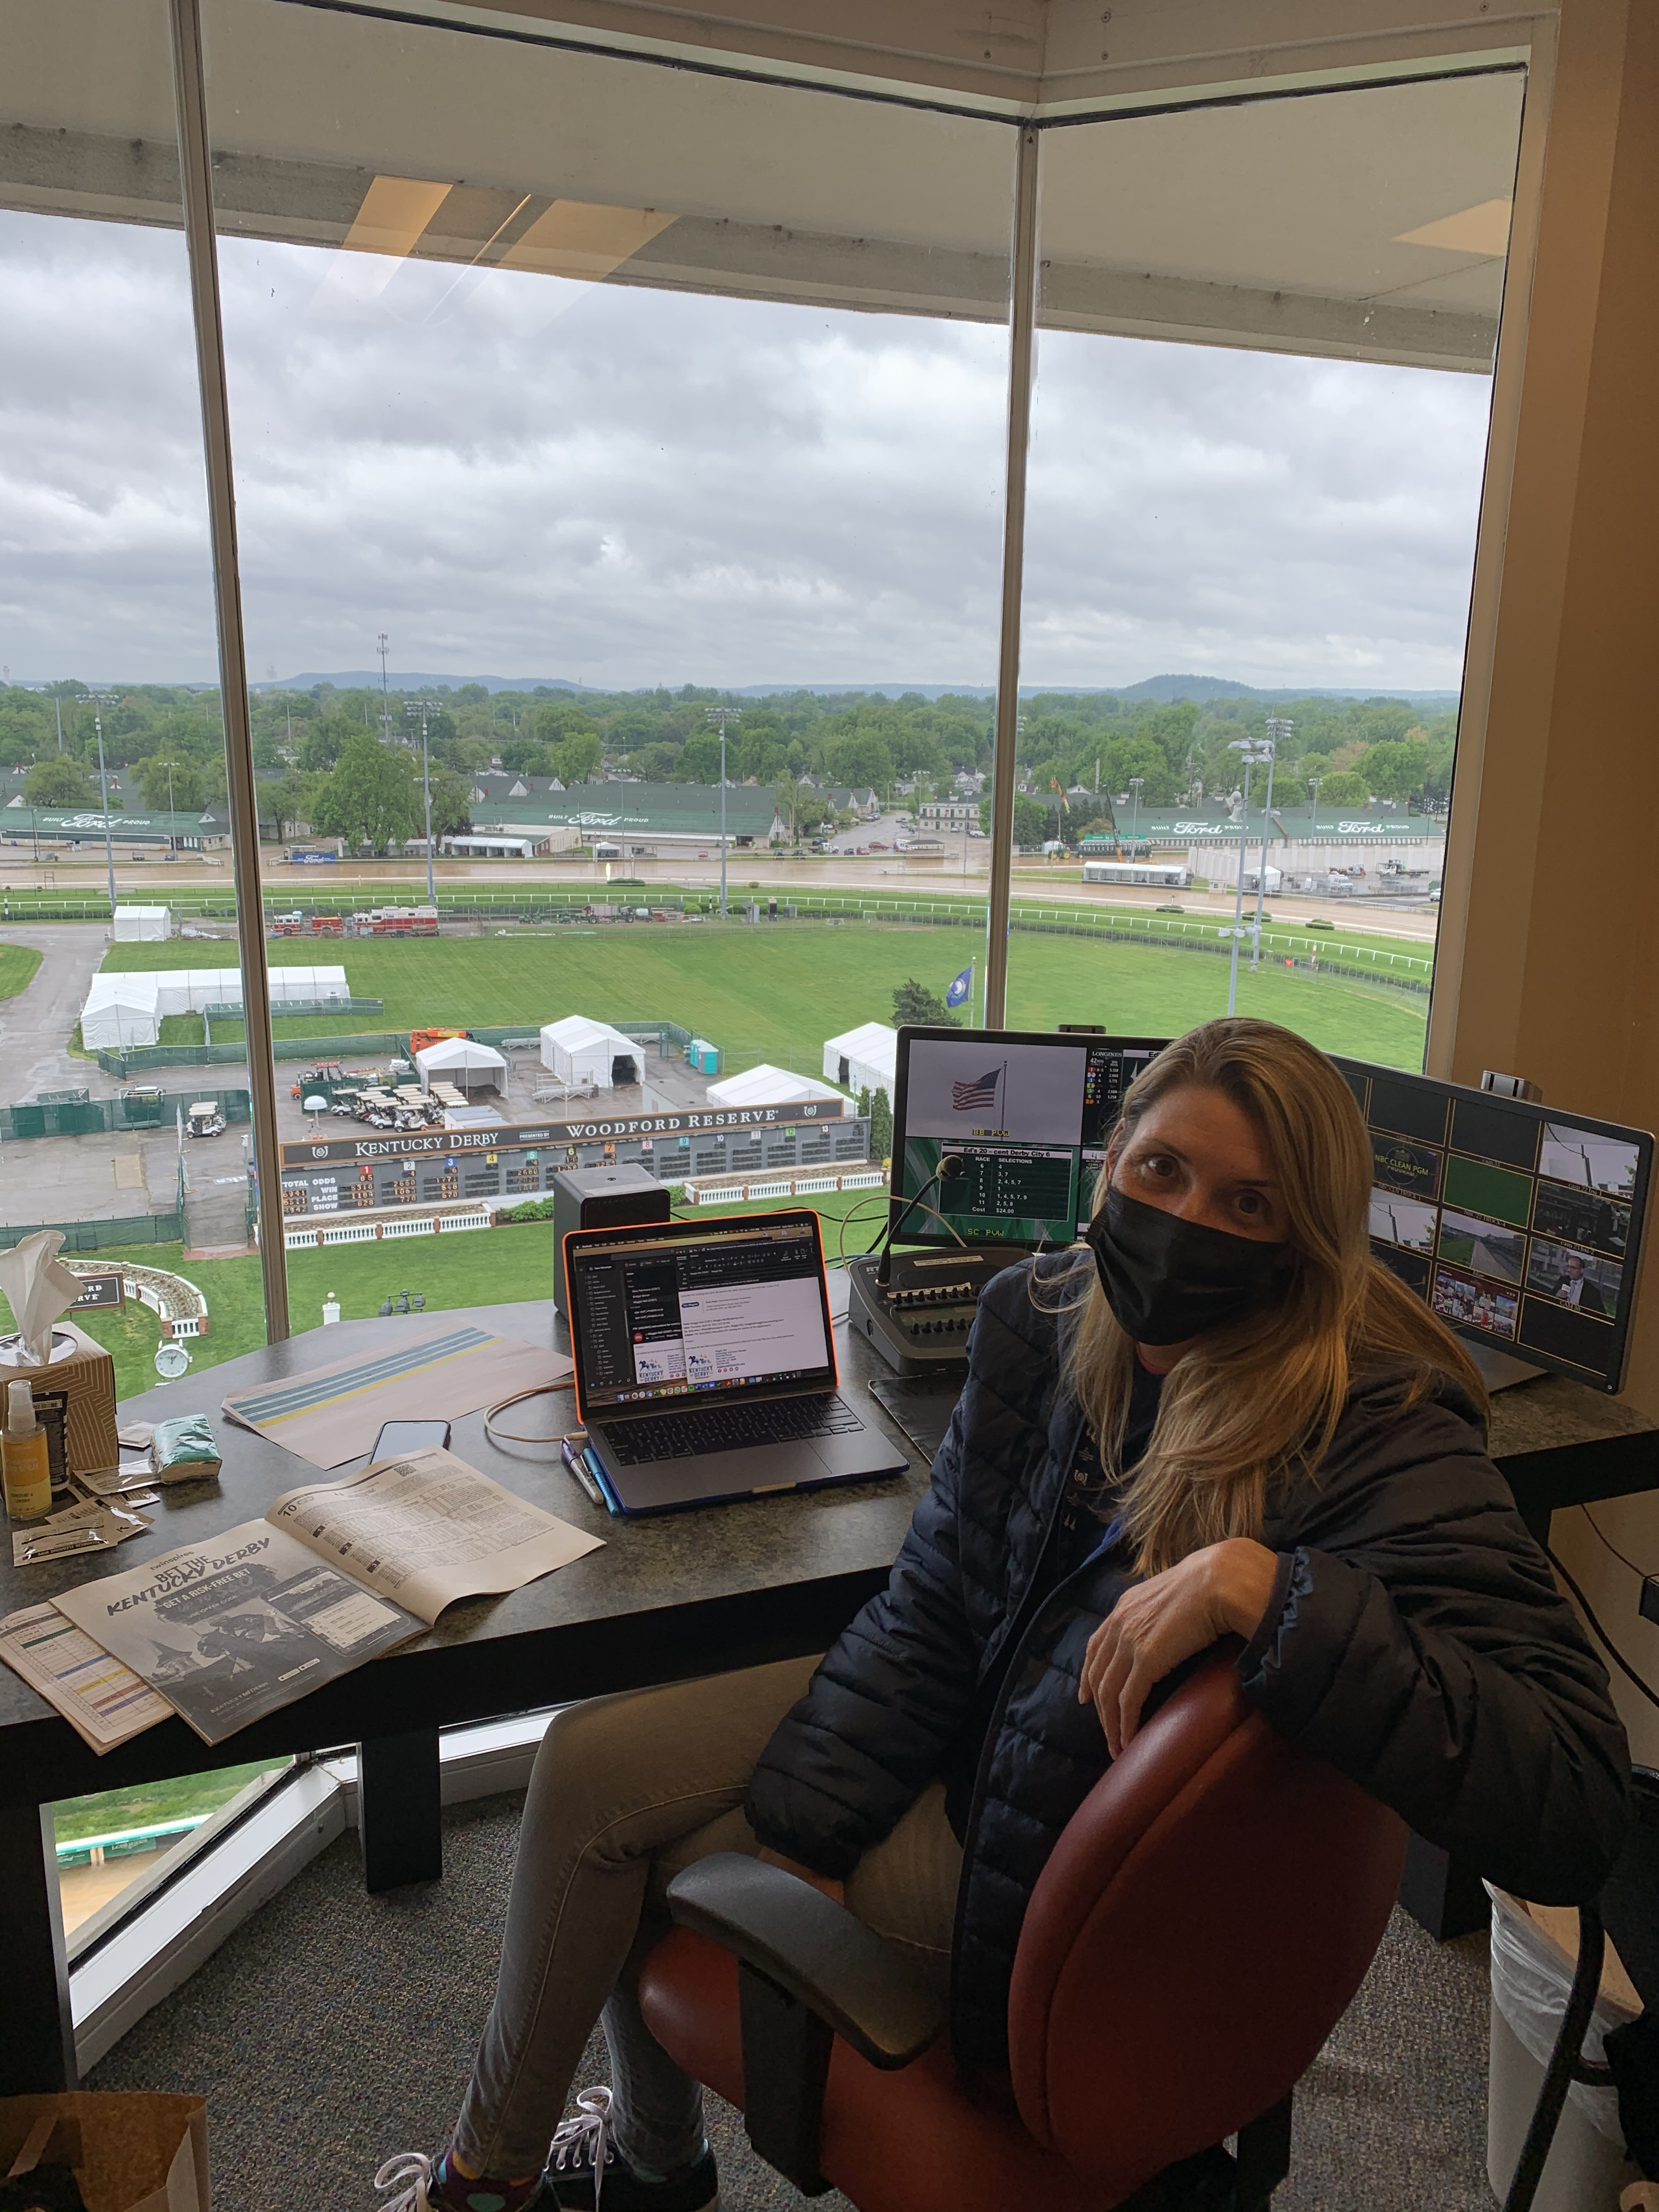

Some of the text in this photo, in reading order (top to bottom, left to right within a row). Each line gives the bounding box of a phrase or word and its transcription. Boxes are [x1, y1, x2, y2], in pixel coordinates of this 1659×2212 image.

[61, 814, 123, 828] Ford
[568, 812, 622, 826] Ford
[1173, 822, 1223, 834] Ford
[1338, 821, 1385, 833] Ford
[304, 855, 324, 863] Ford
[356, 1137, 443, 1157] KENTUCKY
[450, 1132, 499, 1148] DERBY
[566, 1118, 680, 1138] WOODFORD
[448, 1158, 454, 1166] 3
[1374, 1154, 1429, 1176] NBC CLEAN PGM
[312, 1177, 336, 1186] ODDS
[312, 1194, 338, 1203] PLACE
[313, 1202, 338, 1211] SHOW
[1560, 1300, 1573, 1310] CAM
[639, 1370, 663, 1379] KENTUCKY
[689, 1365, 713, 1374] KENTUCKY
[283, 1504, 297, 1517] 10
[150, 1550, 194, 1571] twinspires
[154, 1555, 211, 1583] BET THE
[107, 1538, 270, 1616] KENTUCKY DERBY
[163, 1597, 182, 1609] GET
[188, 1574, 235, 1598] RISK-FREE
[232, 1568, 252, 1579] BET
[200, 1602, 219, 1614] OFFER
[220, 1595, 238, 1605] CODE
